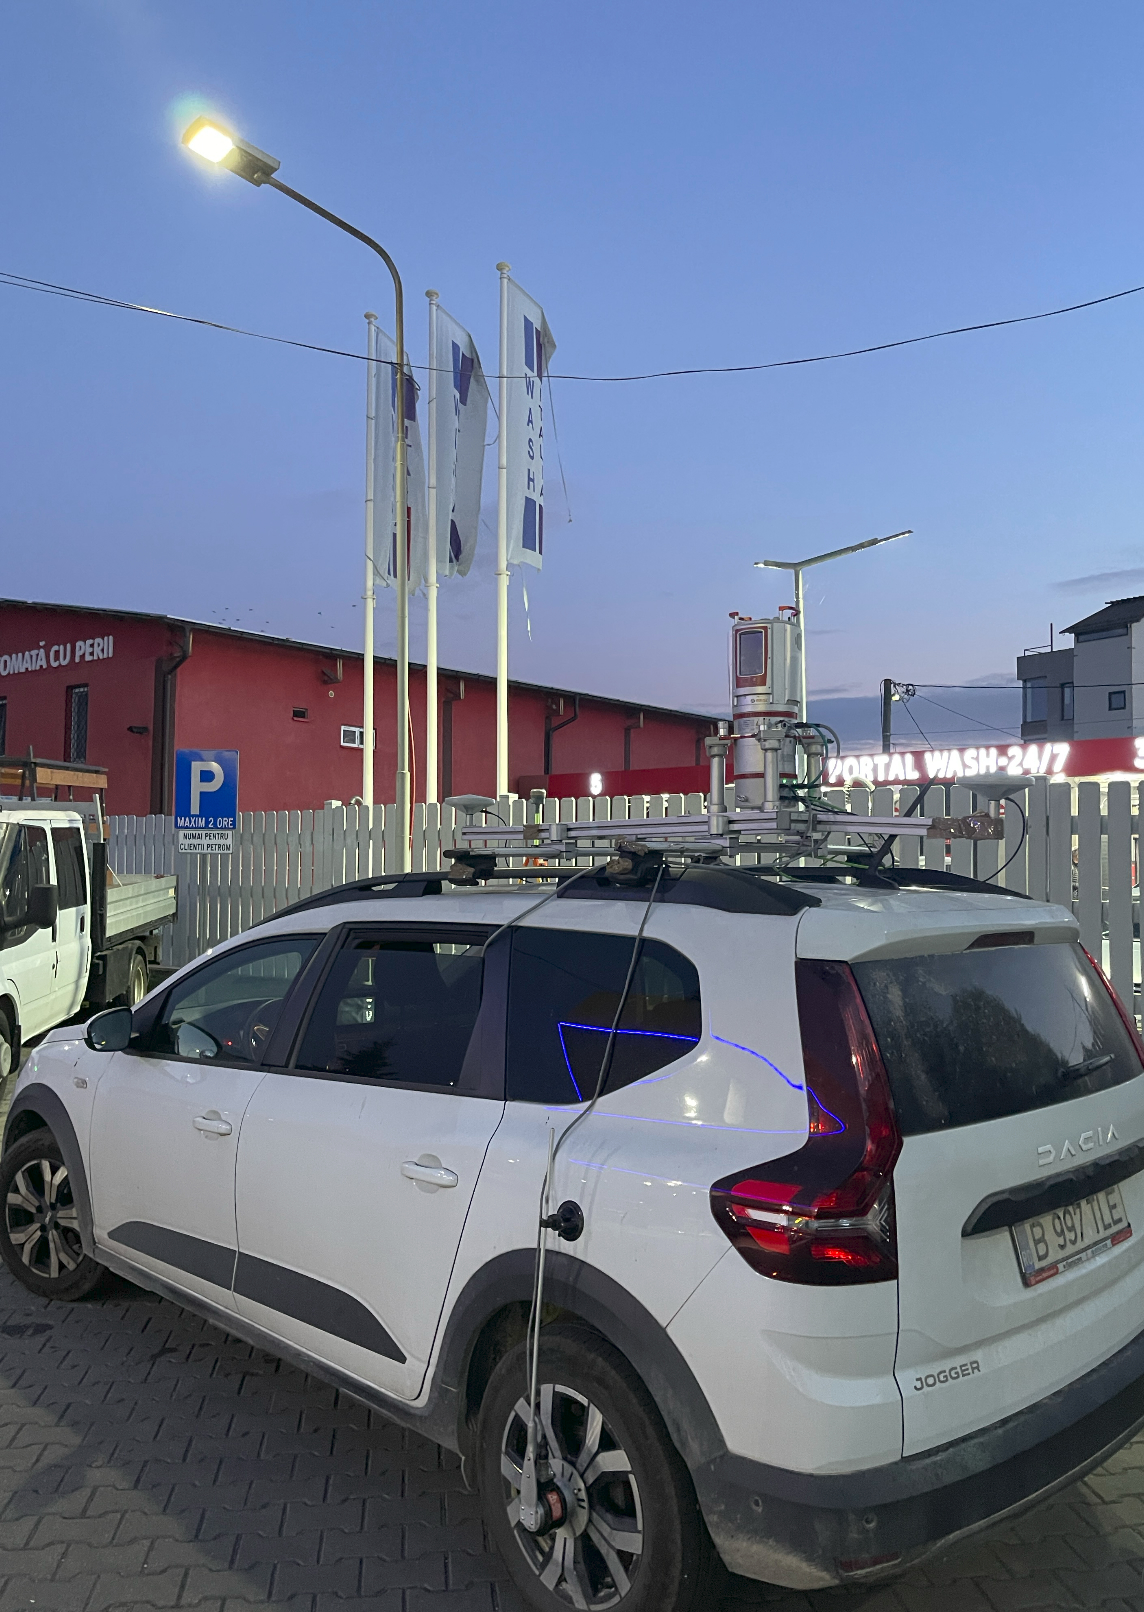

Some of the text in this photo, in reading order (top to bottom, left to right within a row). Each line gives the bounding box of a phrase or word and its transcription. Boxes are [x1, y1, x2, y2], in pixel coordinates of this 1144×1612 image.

[525, 372, 536, 493] WASH
[0, 635, 113, 676] OMATĂ CU PERII
[828, 753, 919, 783] PORTAL
[190, 761, 224, 815] P
[177, 816, 234, 828] MAXIM 2 ORE
[183, 832, 229, 840] NUMAI PENTRU
[179, 843, 231, 851] CLIENTII PETROM
[1037, 1123, 1120, 1167] DACIA
[1029, 1220, 1049, 1262] B
[1052, 1202, 1084, 1250] 997
[1085, 1187, 1123, 1234] TLE
[913, 1360, 981, 1391] JOGGER
